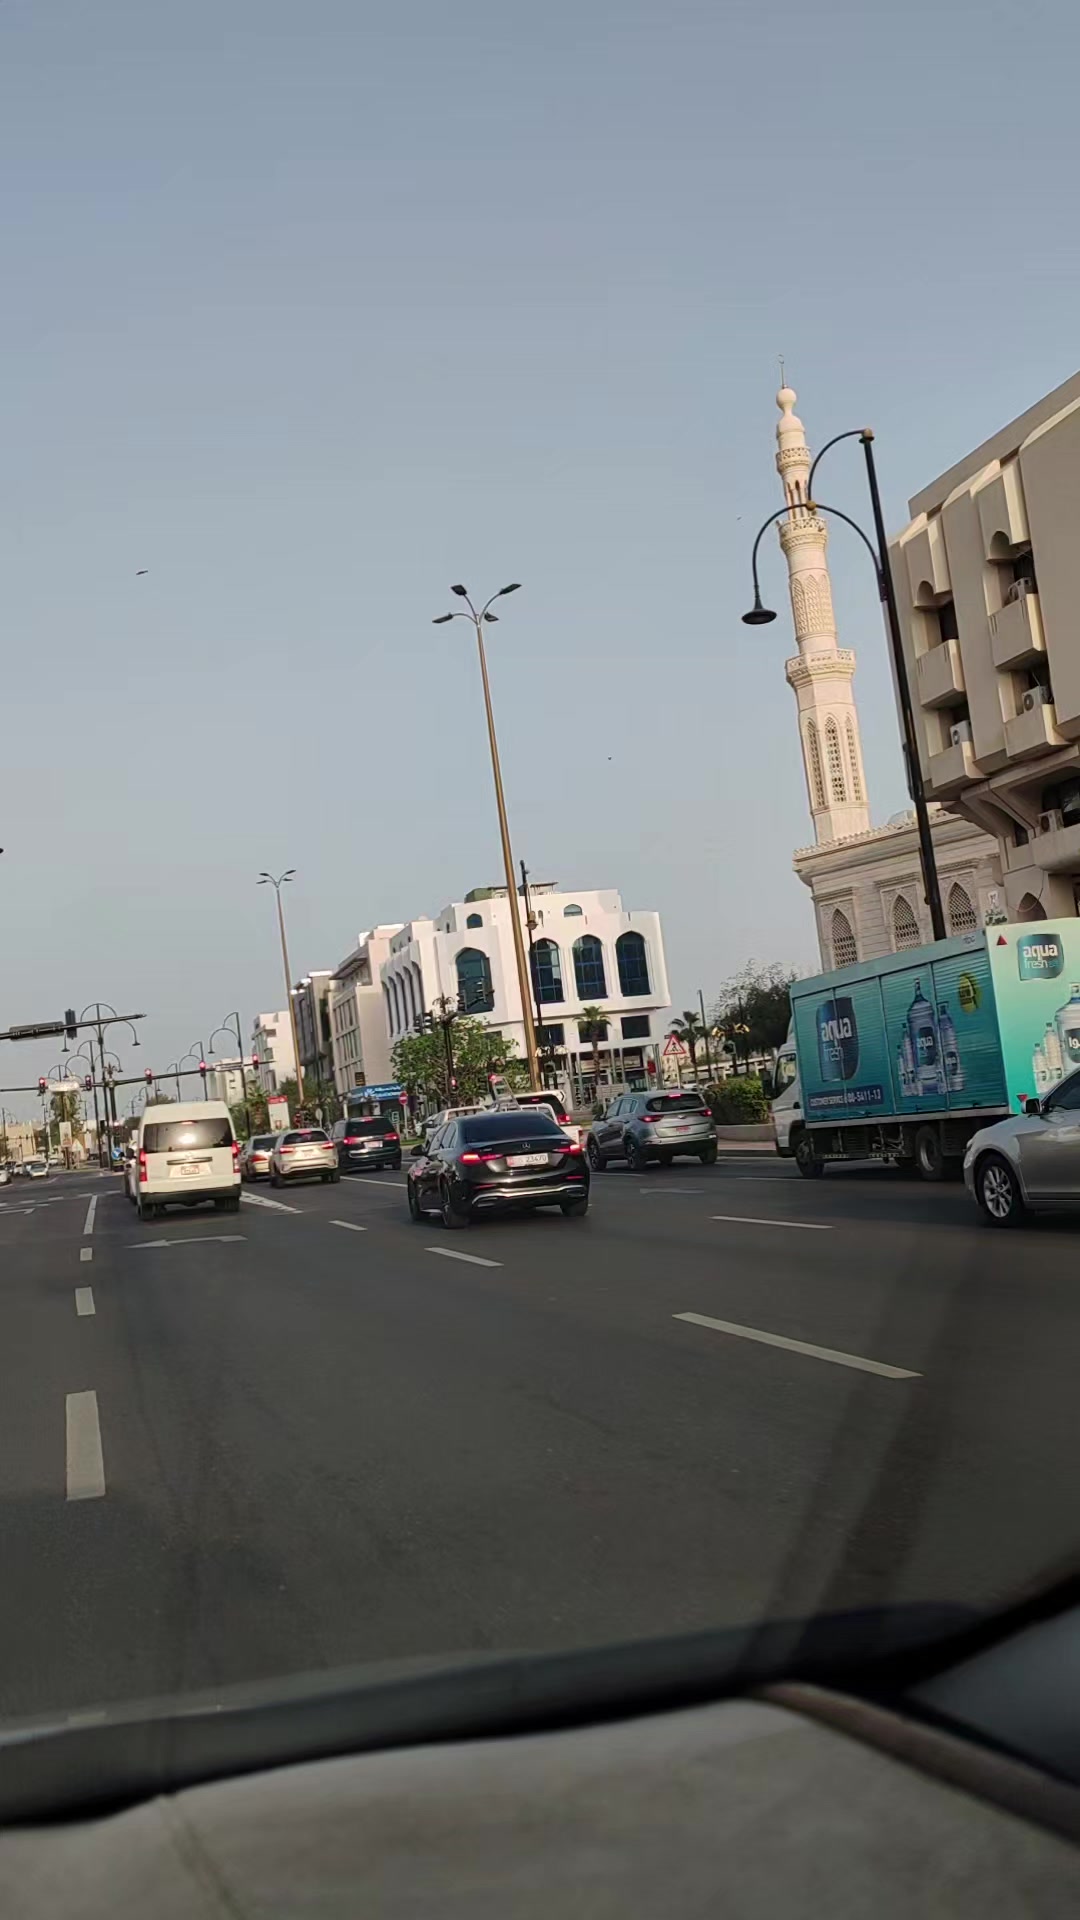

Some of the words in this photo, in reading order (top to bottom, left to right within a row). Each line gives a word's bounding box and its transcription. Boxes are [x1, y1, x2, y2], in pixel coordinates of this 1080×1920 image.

[1022, 943, 1059, 962] aqua
[1024, 959, 1048, 969] fresh
[821, 1017, 852, 1047] aqua
